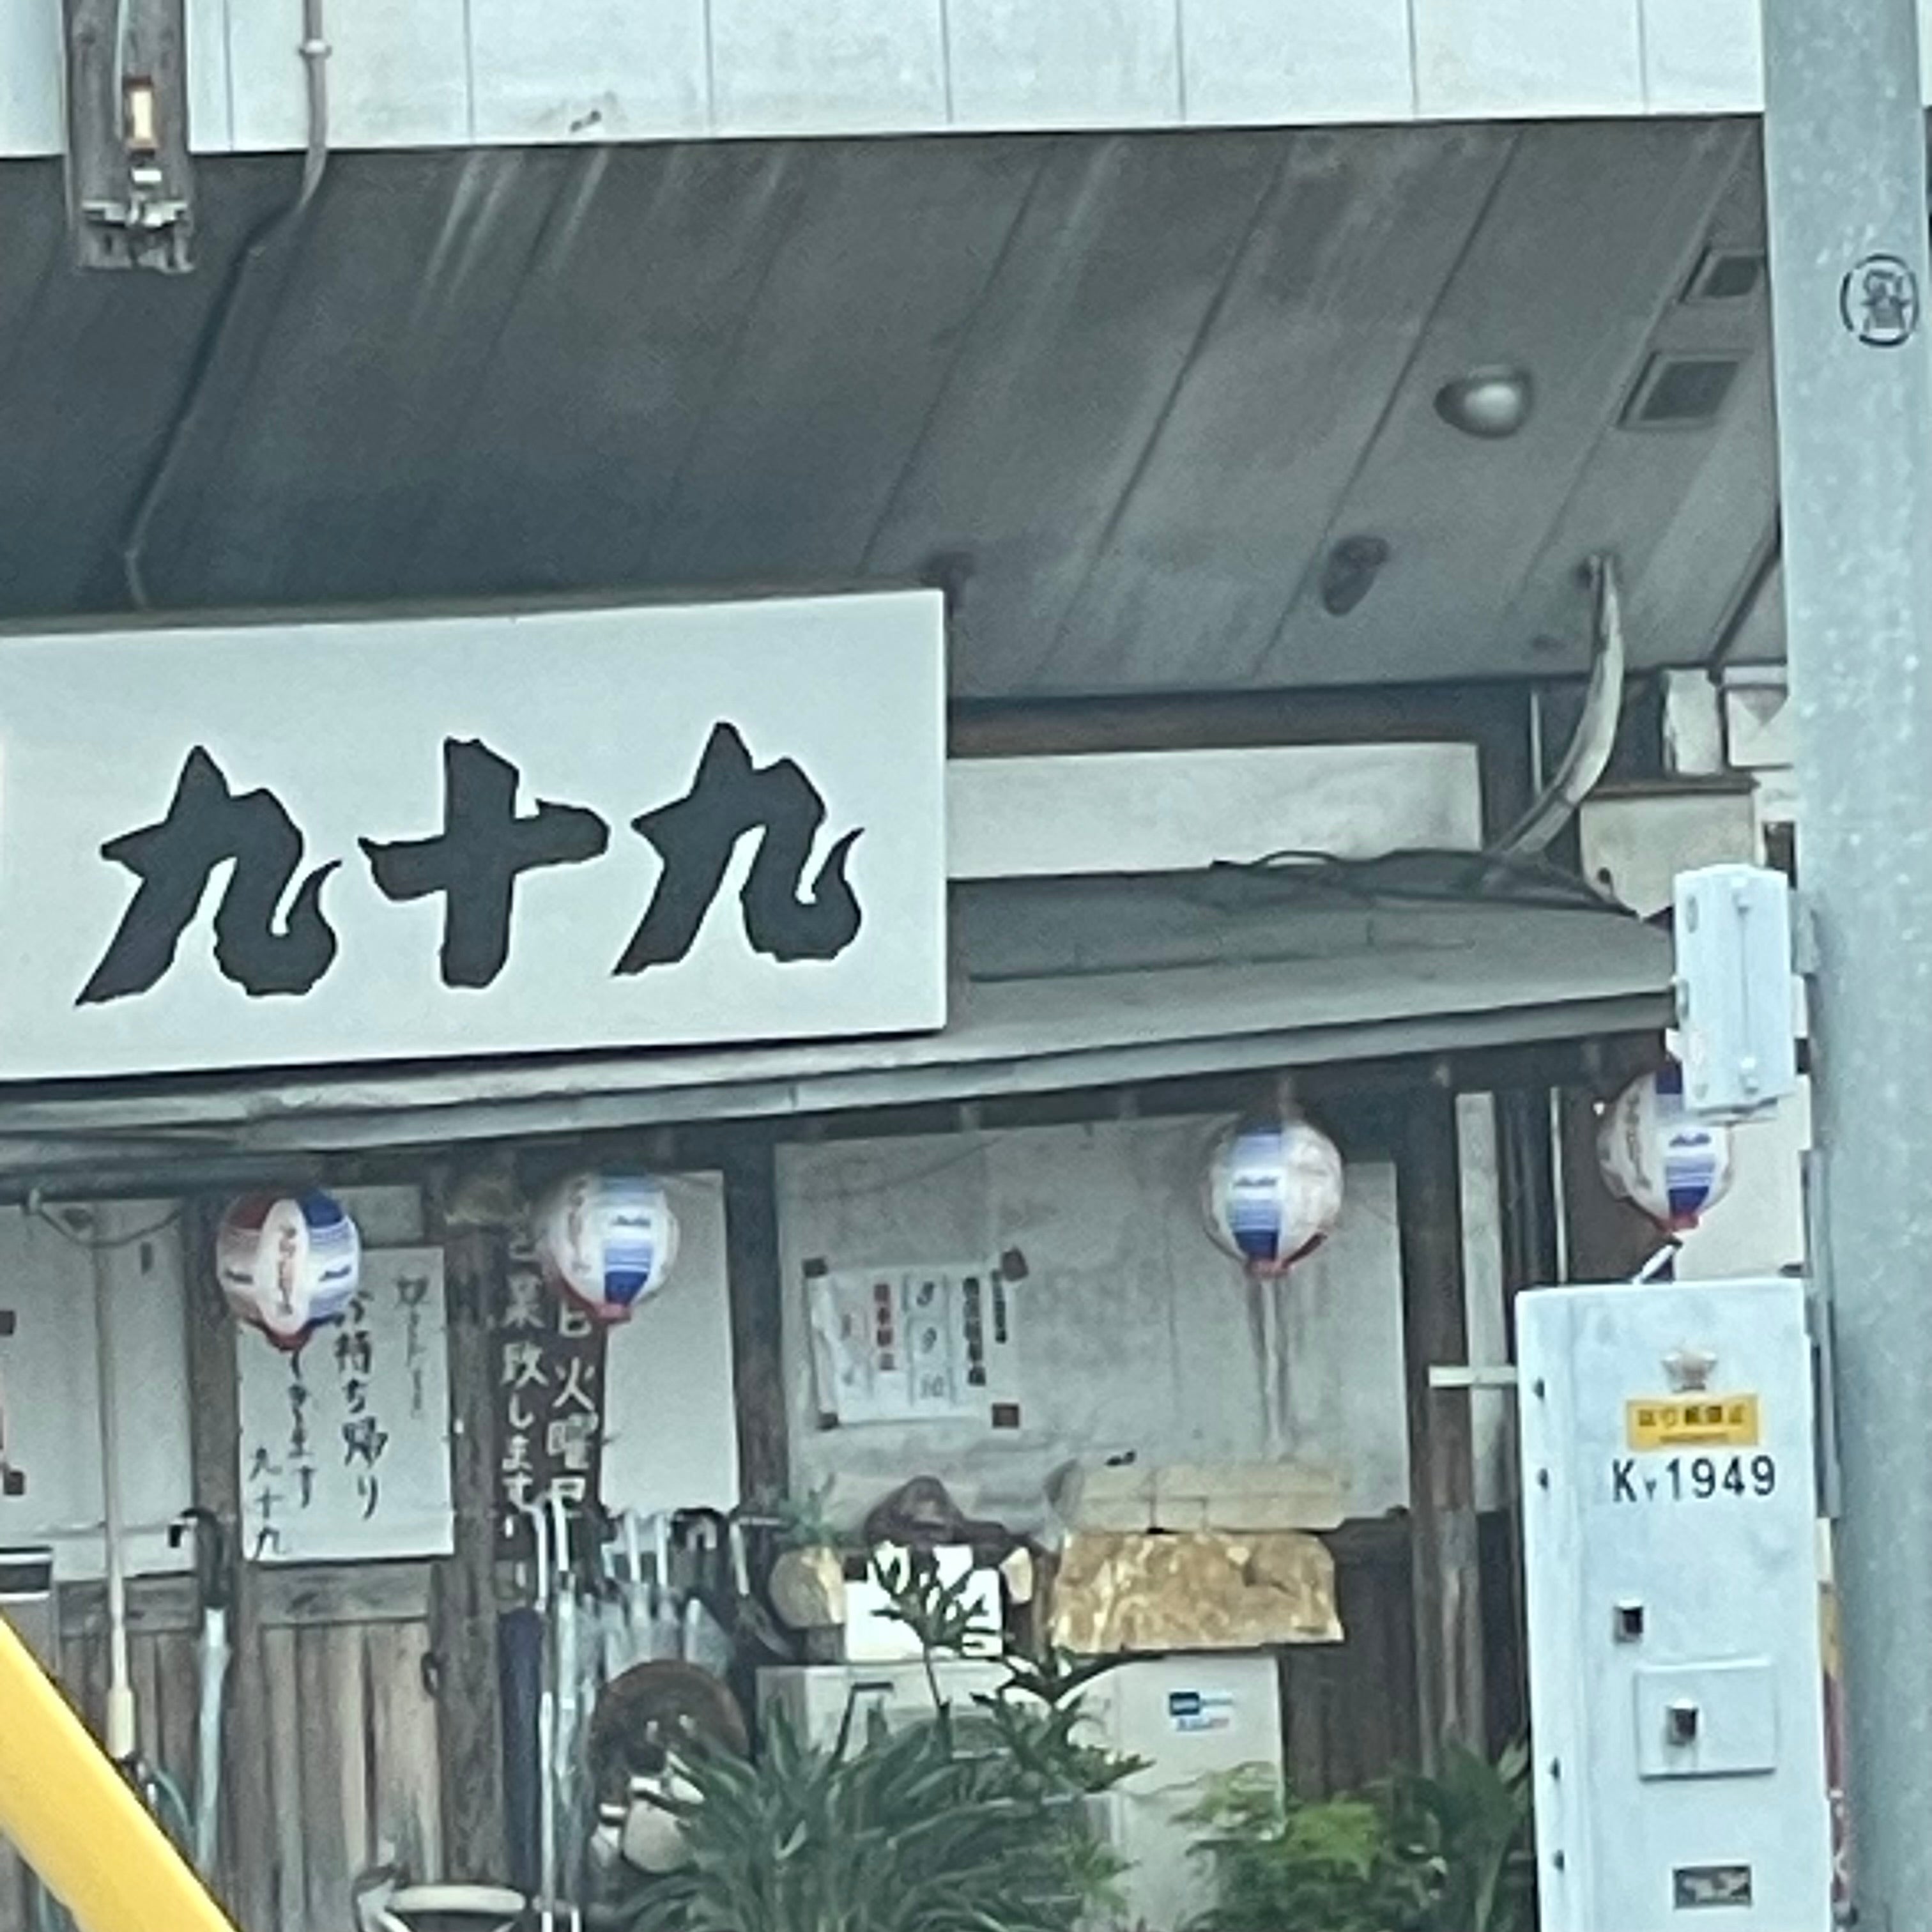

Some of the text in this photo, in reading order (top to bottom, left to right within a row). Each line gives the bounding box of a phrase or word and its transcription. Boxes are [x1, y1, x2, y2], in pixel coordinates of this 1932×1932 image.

[75, 721, 865, 1006] 九十九
[250, 1445, 289, 1558] 九十九
